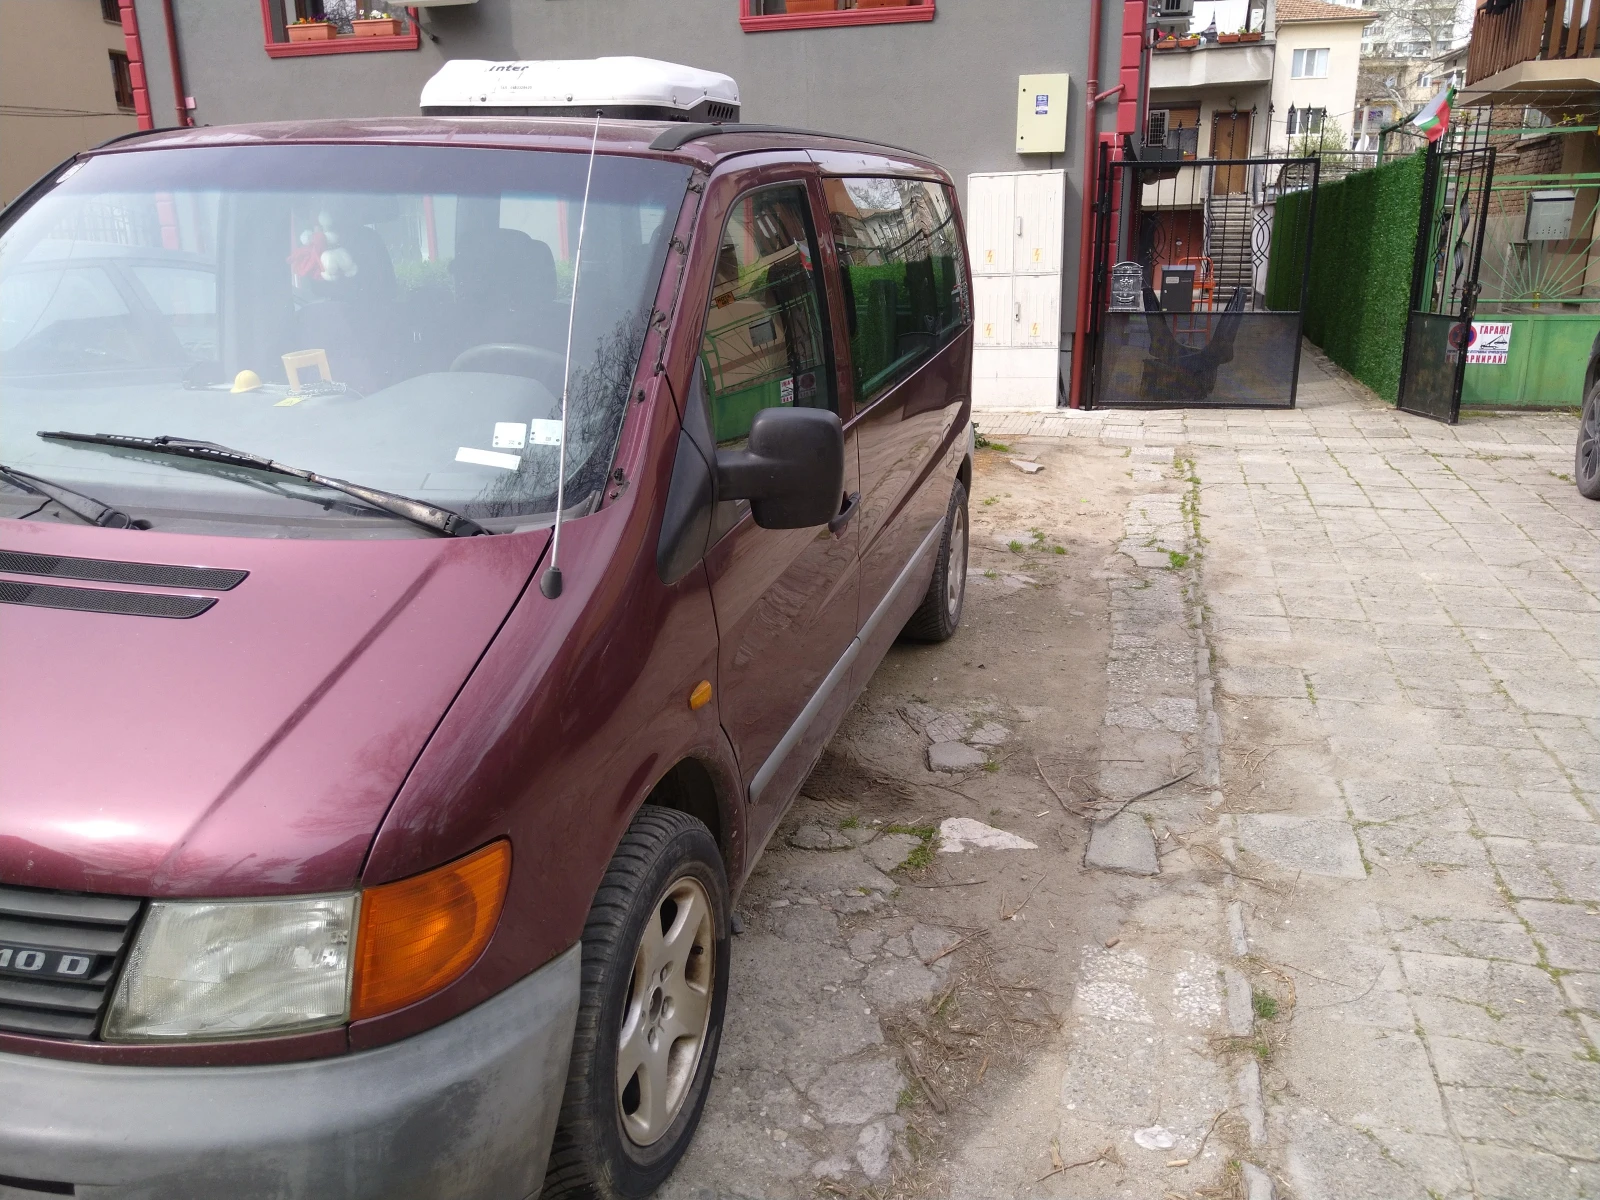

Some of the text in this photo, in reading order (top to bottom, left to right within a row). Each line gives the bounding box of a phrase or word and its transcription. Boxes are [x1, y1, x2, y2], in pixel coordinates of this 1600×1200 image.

[1479, 325, 1510, 335] ГАРАЖ!
[1465, 353, 1507, 364] АРКИРАЙ!
[56, 954, 90, 975] D
